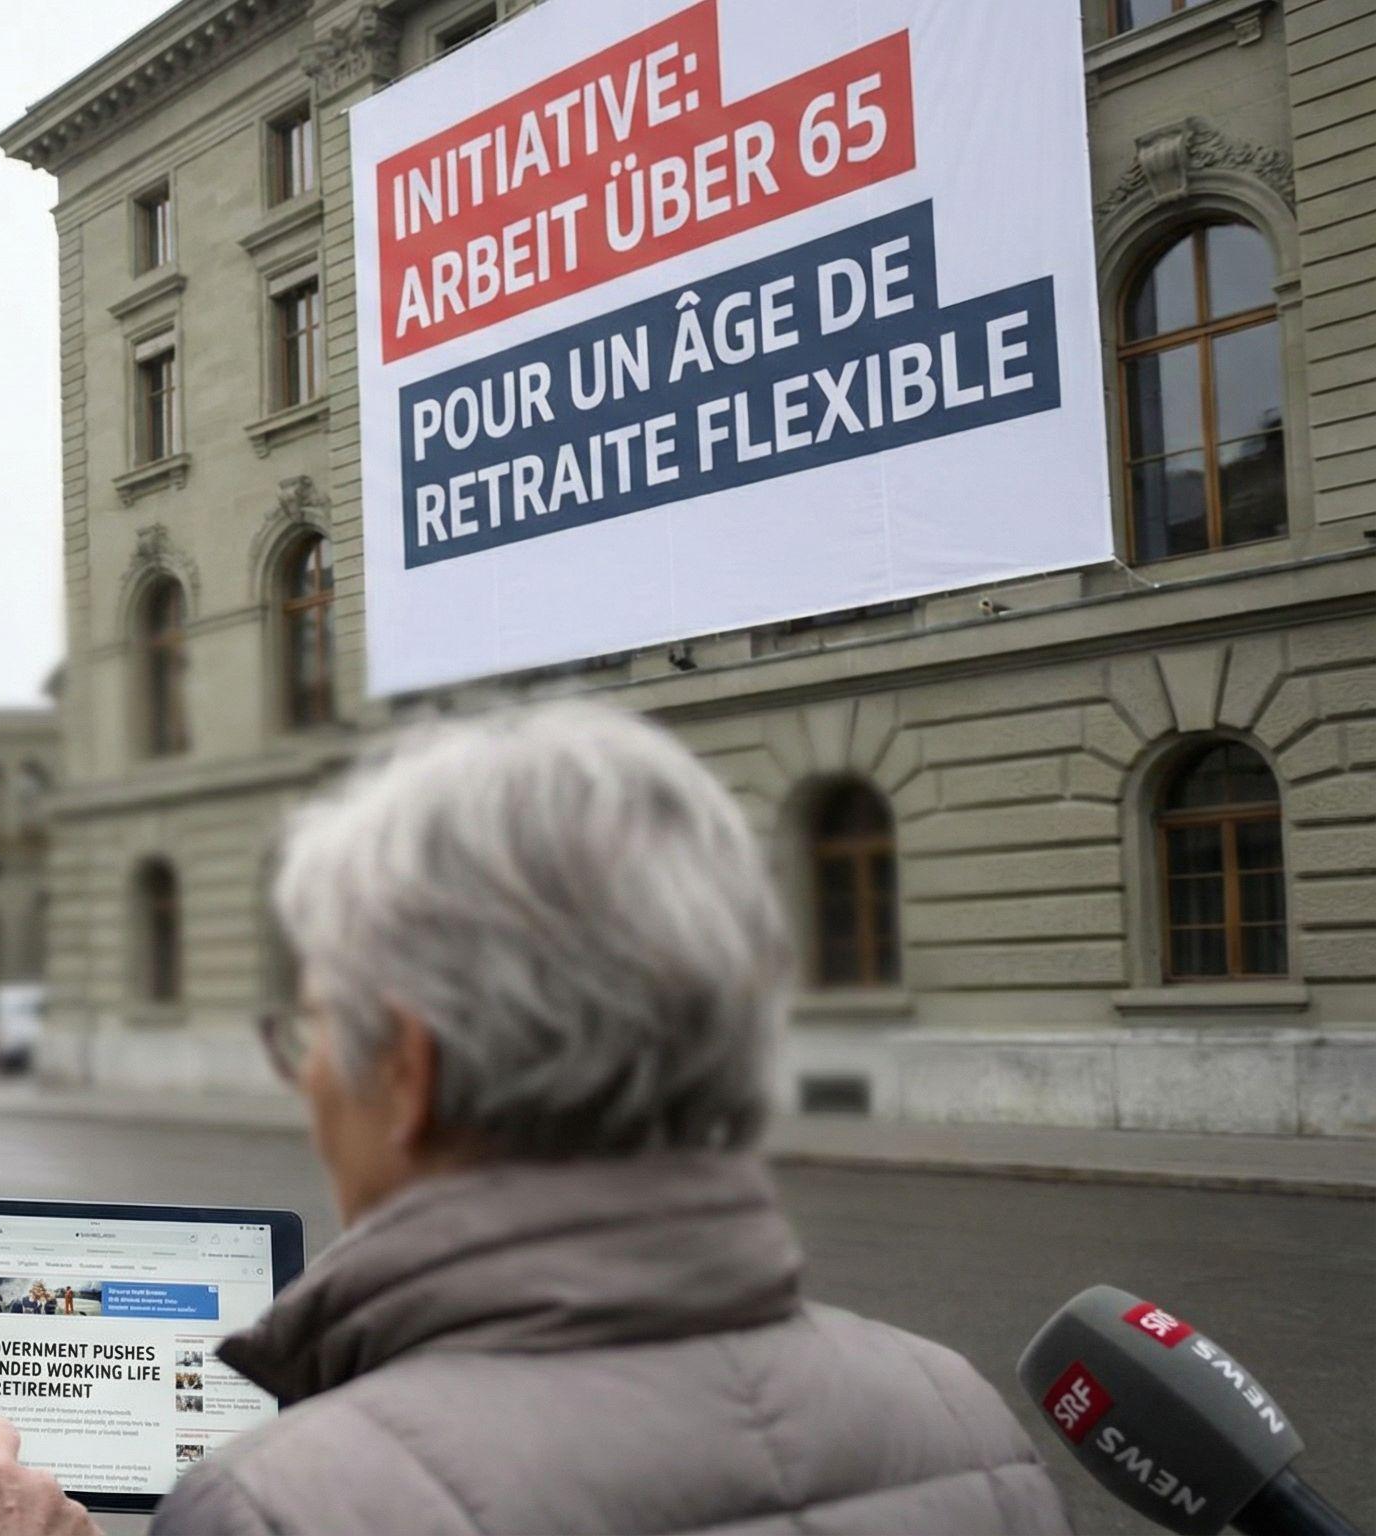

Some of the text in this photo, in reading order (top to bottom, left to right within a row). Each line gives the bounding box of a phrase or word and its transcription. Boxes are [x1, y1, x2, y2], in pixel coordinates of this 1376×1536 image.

[392, 41, 700, 241] INITIATIVE:
[395, 72, 888, 339] ARBEIT ÜBER 65
[412, 234, 915, 463] POUR UN ÂGE DE
[415, 309, 1035, 548] RETRAITE FLEXIBLE
[46, 1362, 122, 1380] WORKING
[127, 1365, 161, 1381] LIFE
[93, 1344, 156, 1362] PUSHES
[1191, 1340, 1285, 1434] NEWS
[1053, 1377, 1091, 1430] SRF
[1096, 1426, 1207, 1516] NEWS
